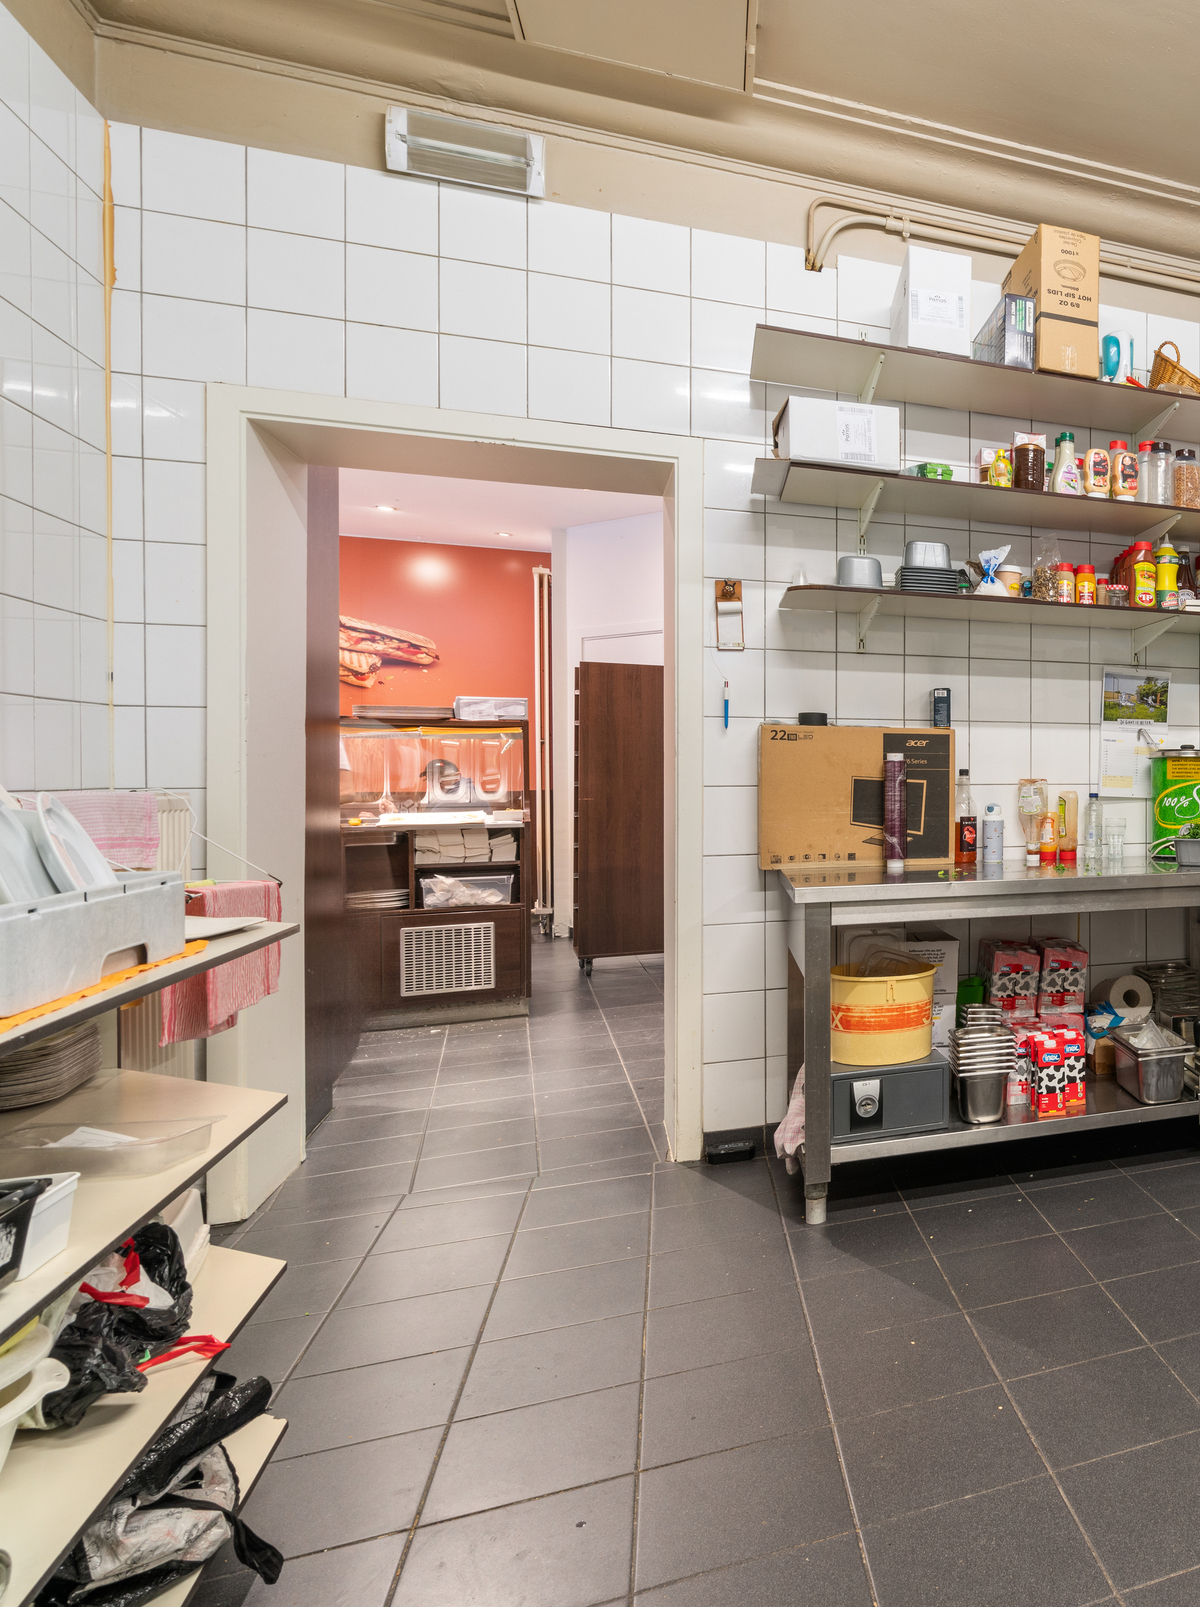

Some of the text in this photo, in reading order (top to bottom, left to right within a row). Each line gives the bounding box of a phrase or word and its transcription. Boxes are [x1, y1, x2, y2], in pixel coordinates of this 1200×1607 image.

[1047, 288, 1063, 296] LIDS
[770, 730, 786, 740] 22
[1162, 796, 1192, 807] 100%
